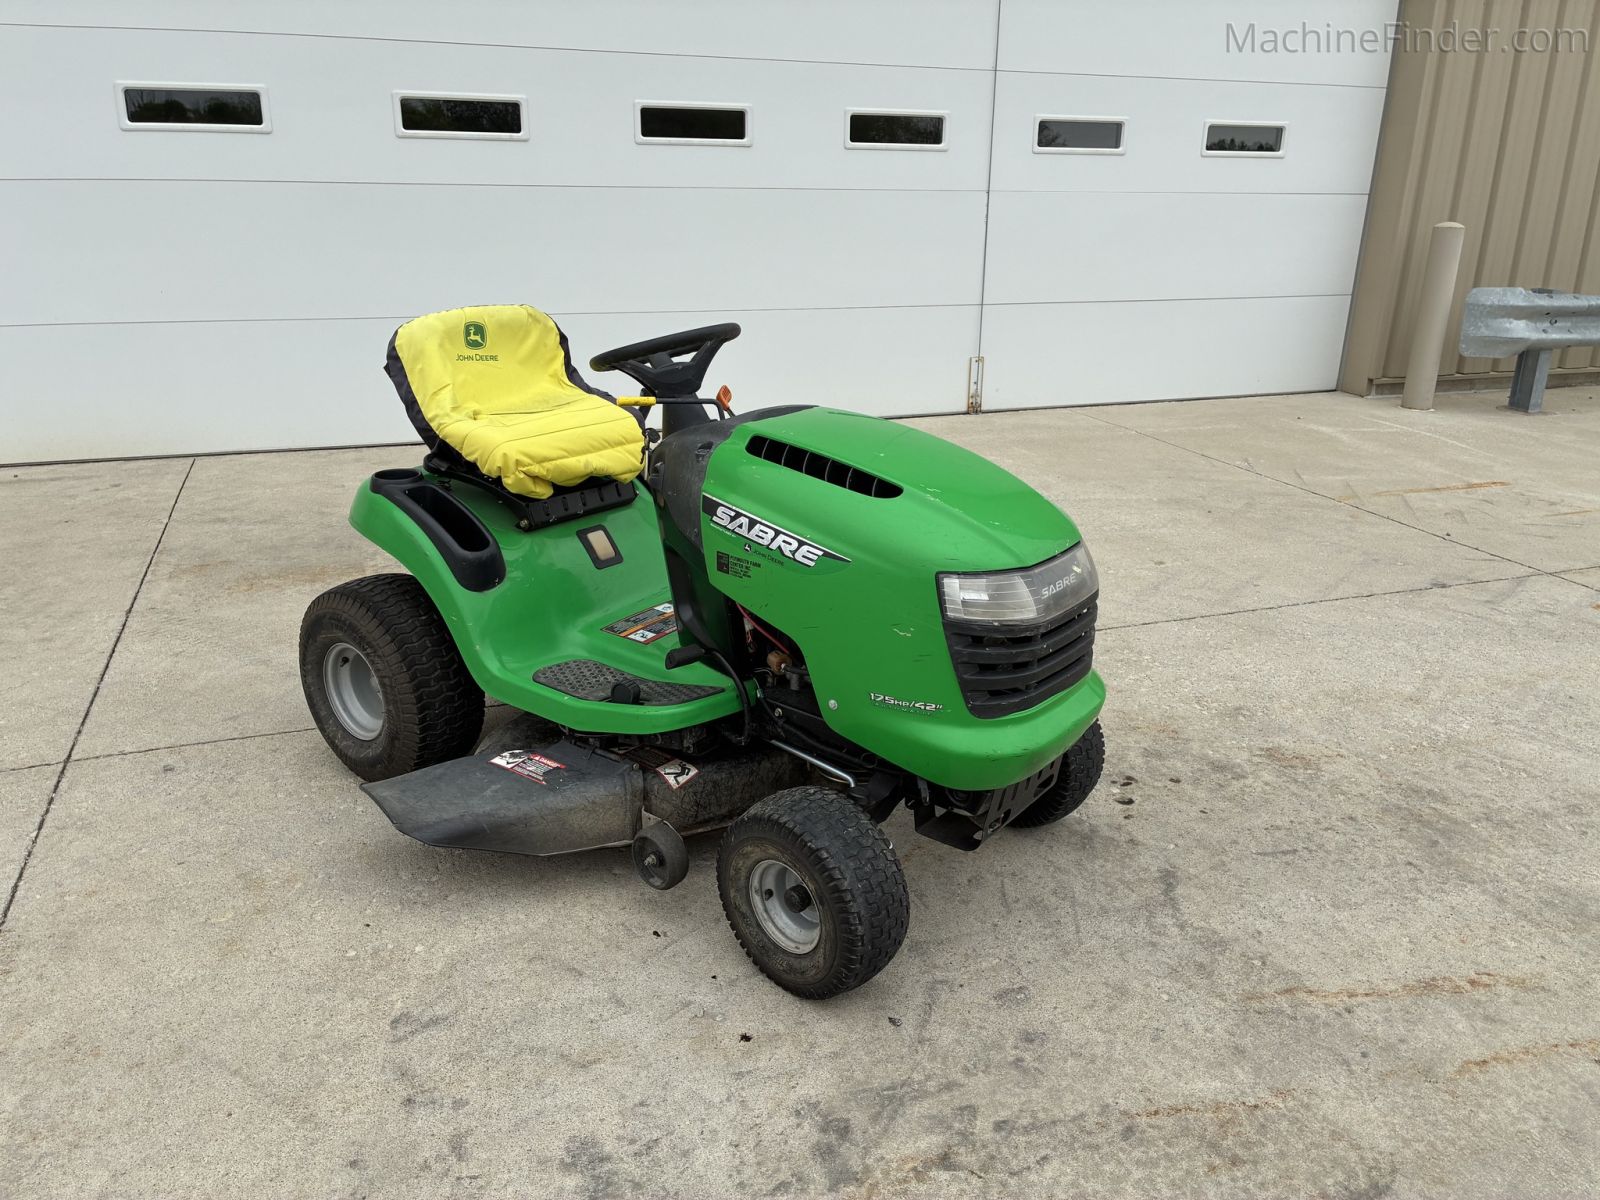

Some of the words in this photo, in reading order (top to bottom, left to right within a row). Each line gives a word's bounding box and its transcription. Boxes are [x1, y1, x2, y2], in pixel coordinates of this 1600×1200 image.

[456, 353, 474, 361] JOHN
[475, 353, 499, 362] DEERE
[711, 505, 824, 567] SABRE
[1041, 572, 1076, 599] SABRE
